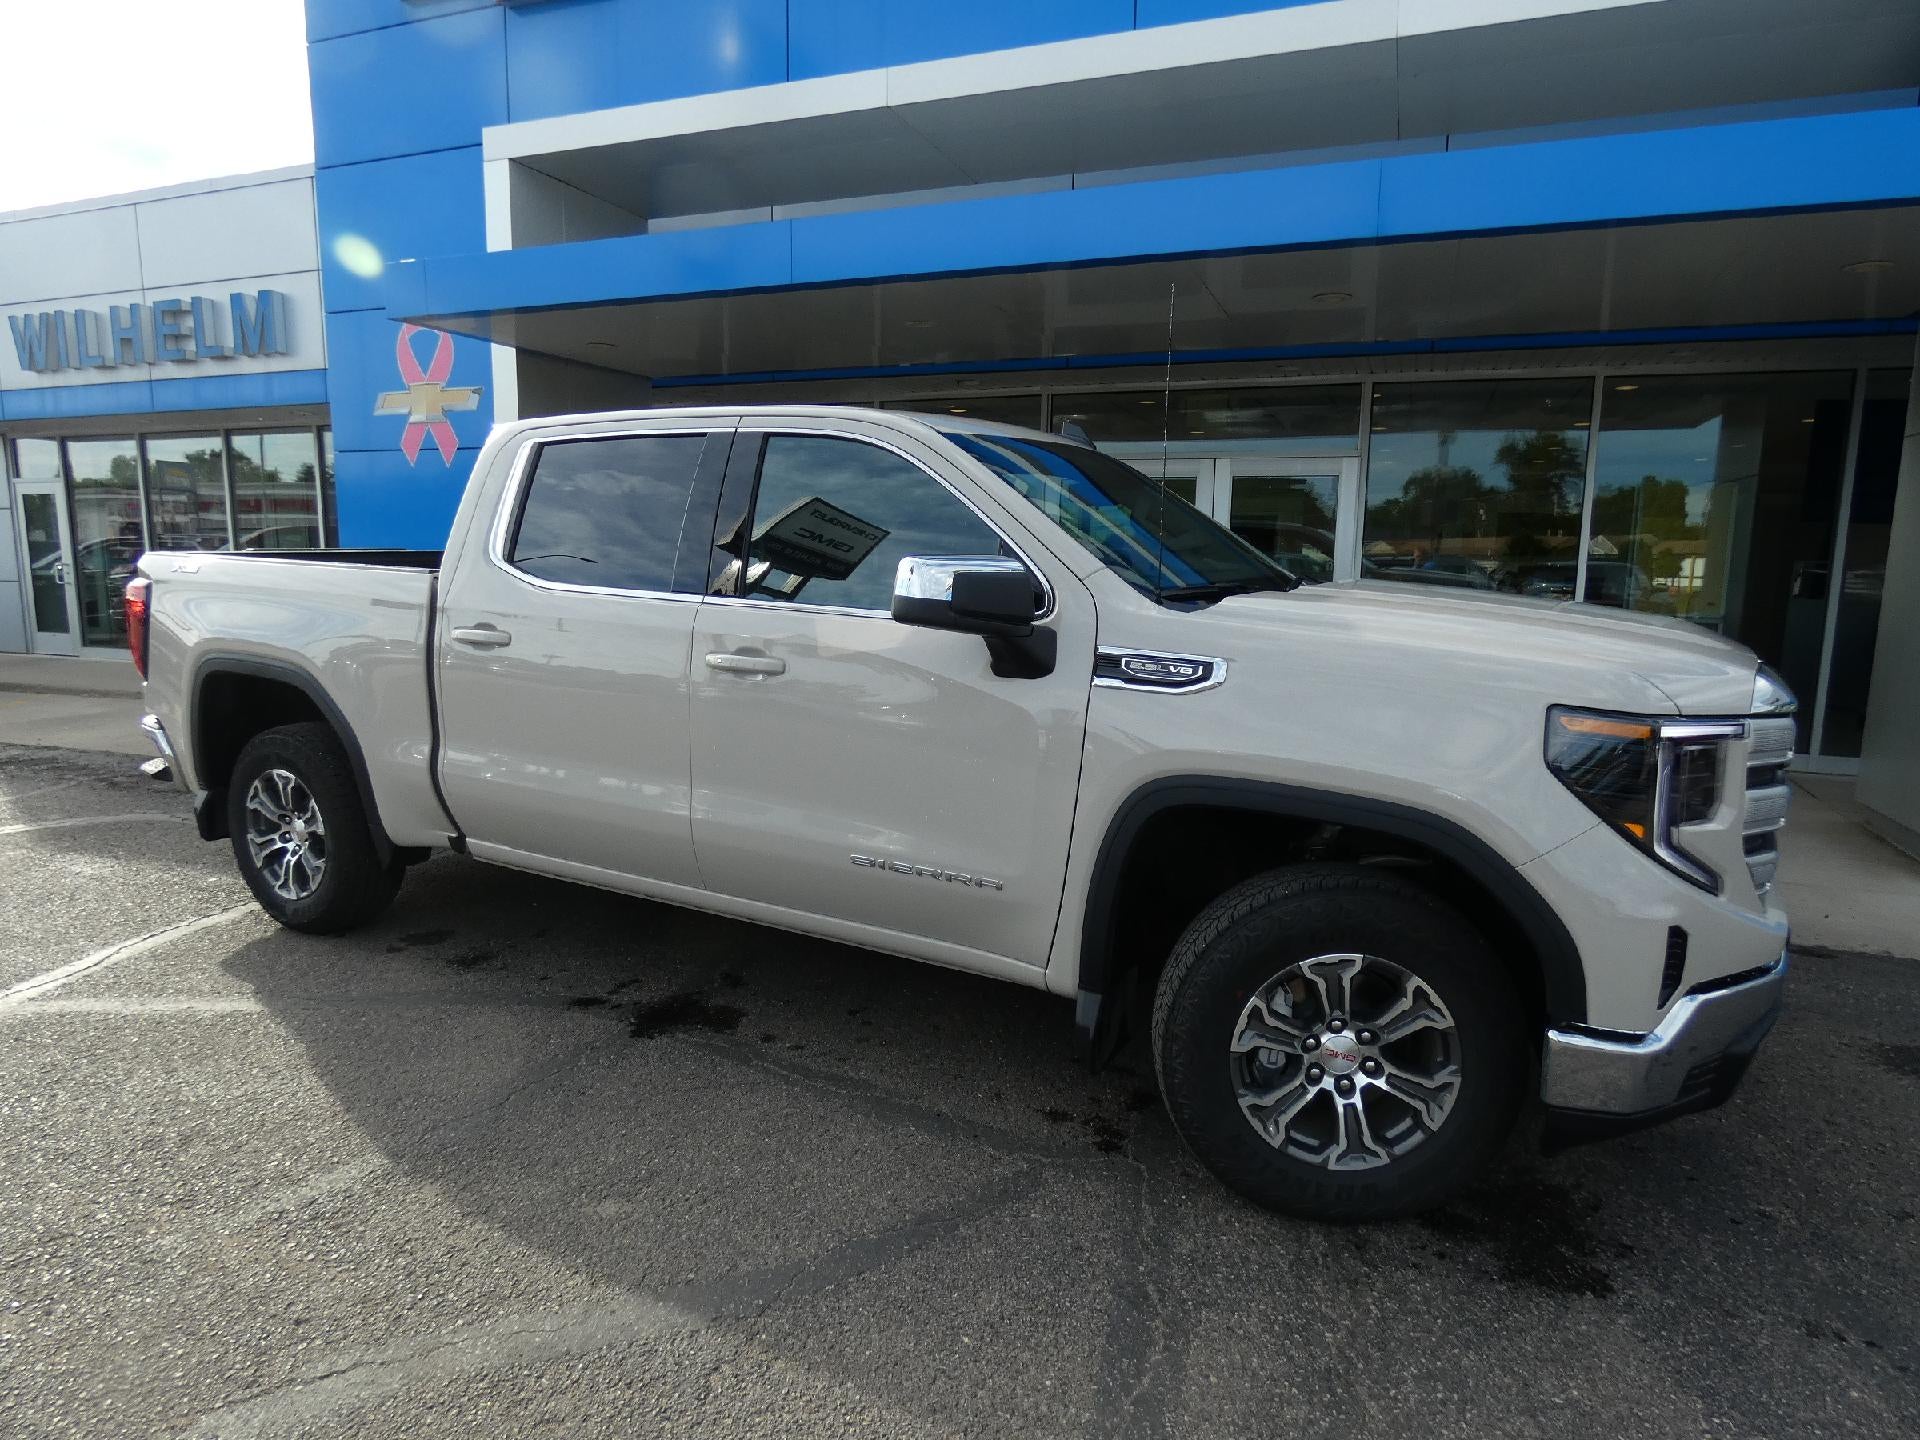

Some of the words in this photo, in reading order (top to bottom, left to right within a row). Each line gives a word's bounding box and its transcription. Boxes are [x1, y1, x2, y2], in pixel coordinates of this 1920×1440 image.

[8, 290, 286, 371] WILHELM
[850, 854, 1003, 891] SIERRA
[1325, 1048, 1356, 1062] GMC
